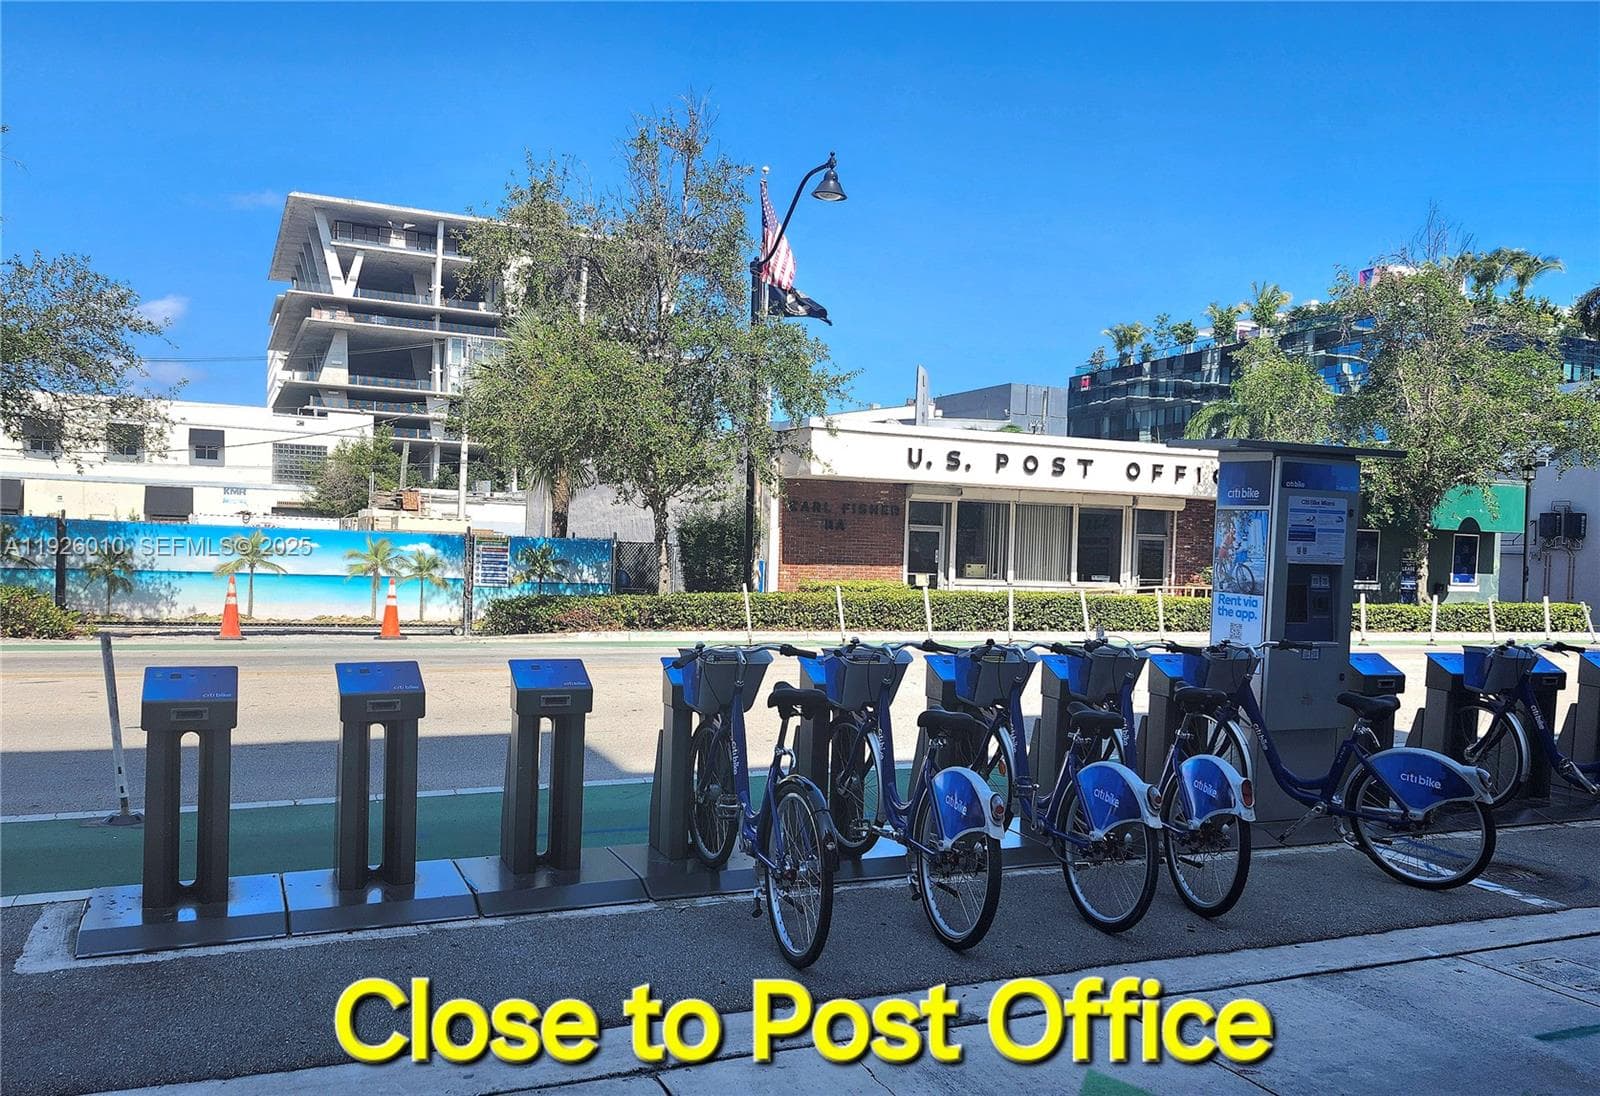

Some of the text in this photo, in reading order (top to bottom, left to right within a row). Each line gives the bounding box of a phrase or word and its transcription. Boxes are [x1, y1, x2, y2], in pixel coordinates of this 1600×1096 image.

[907, 447, 971, 473] U.S.
[995, 452, 1093, 479] POST
[1218, 594, 1258, 608] Rent via
[1217, 606, 1258, 622] the app.
